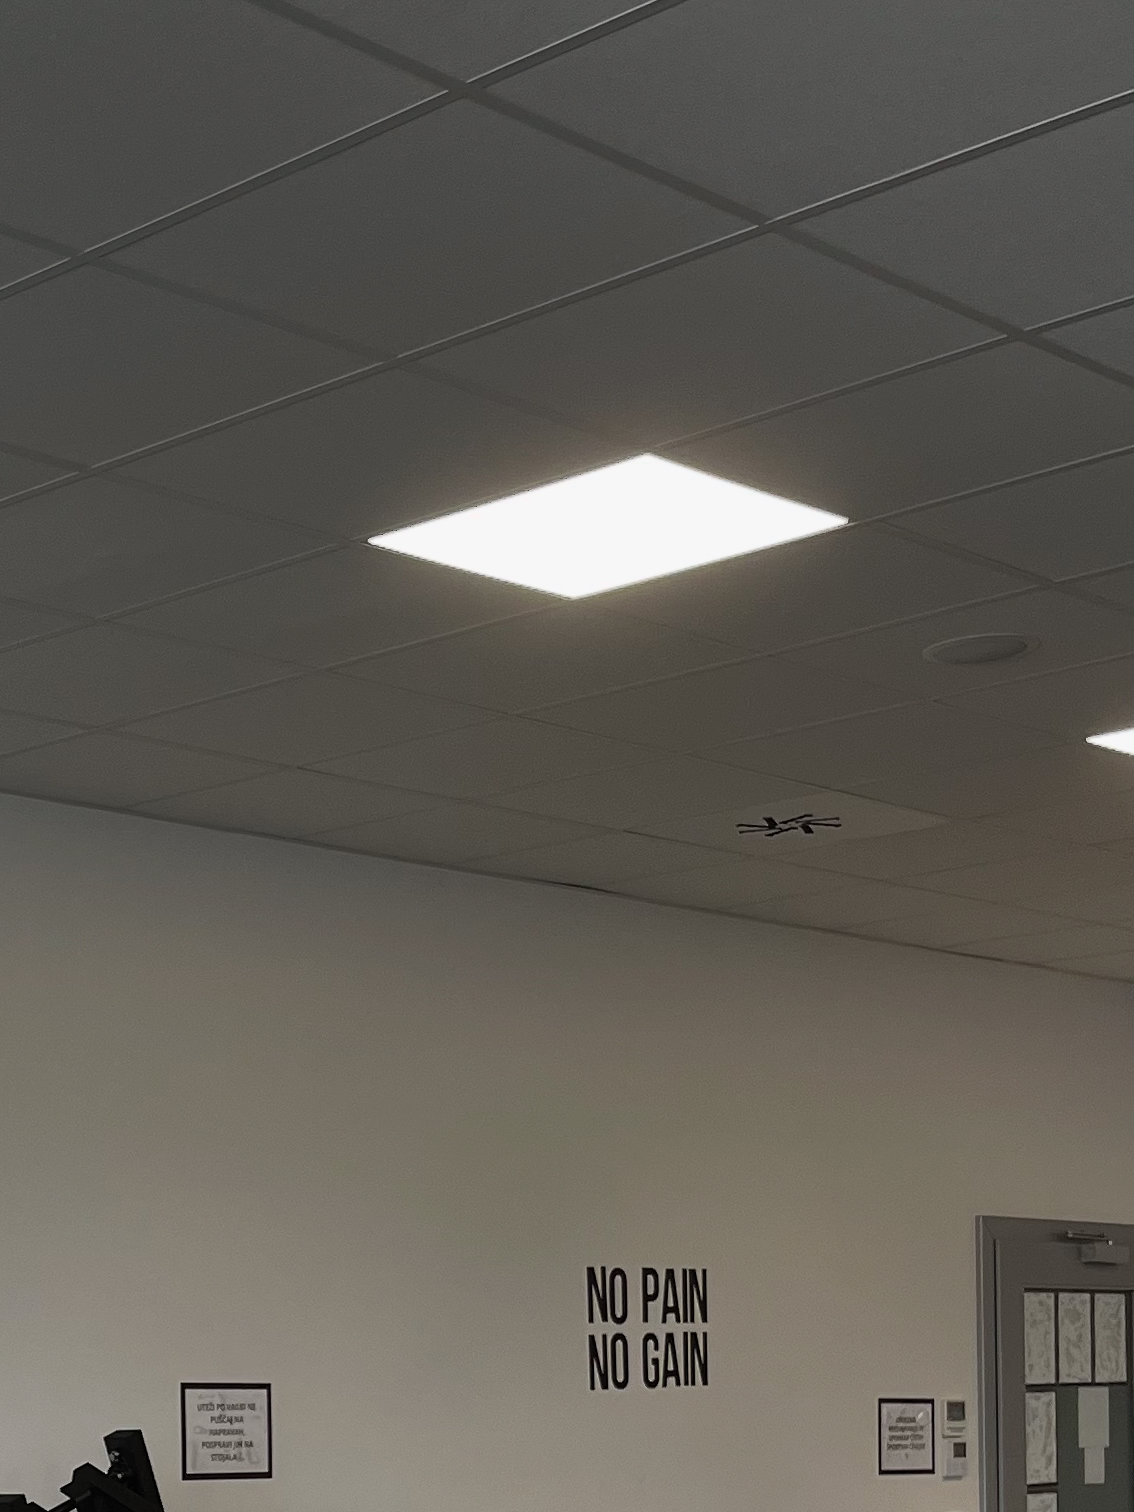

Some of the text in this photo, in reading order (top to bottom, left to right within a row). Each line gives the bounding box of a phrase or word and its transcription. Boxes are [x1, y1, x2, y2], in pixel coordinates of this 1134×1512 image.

[586, 1266, 708, 1325] NO PAIN
[588, 1331, 708, 1391] NO GAIN
